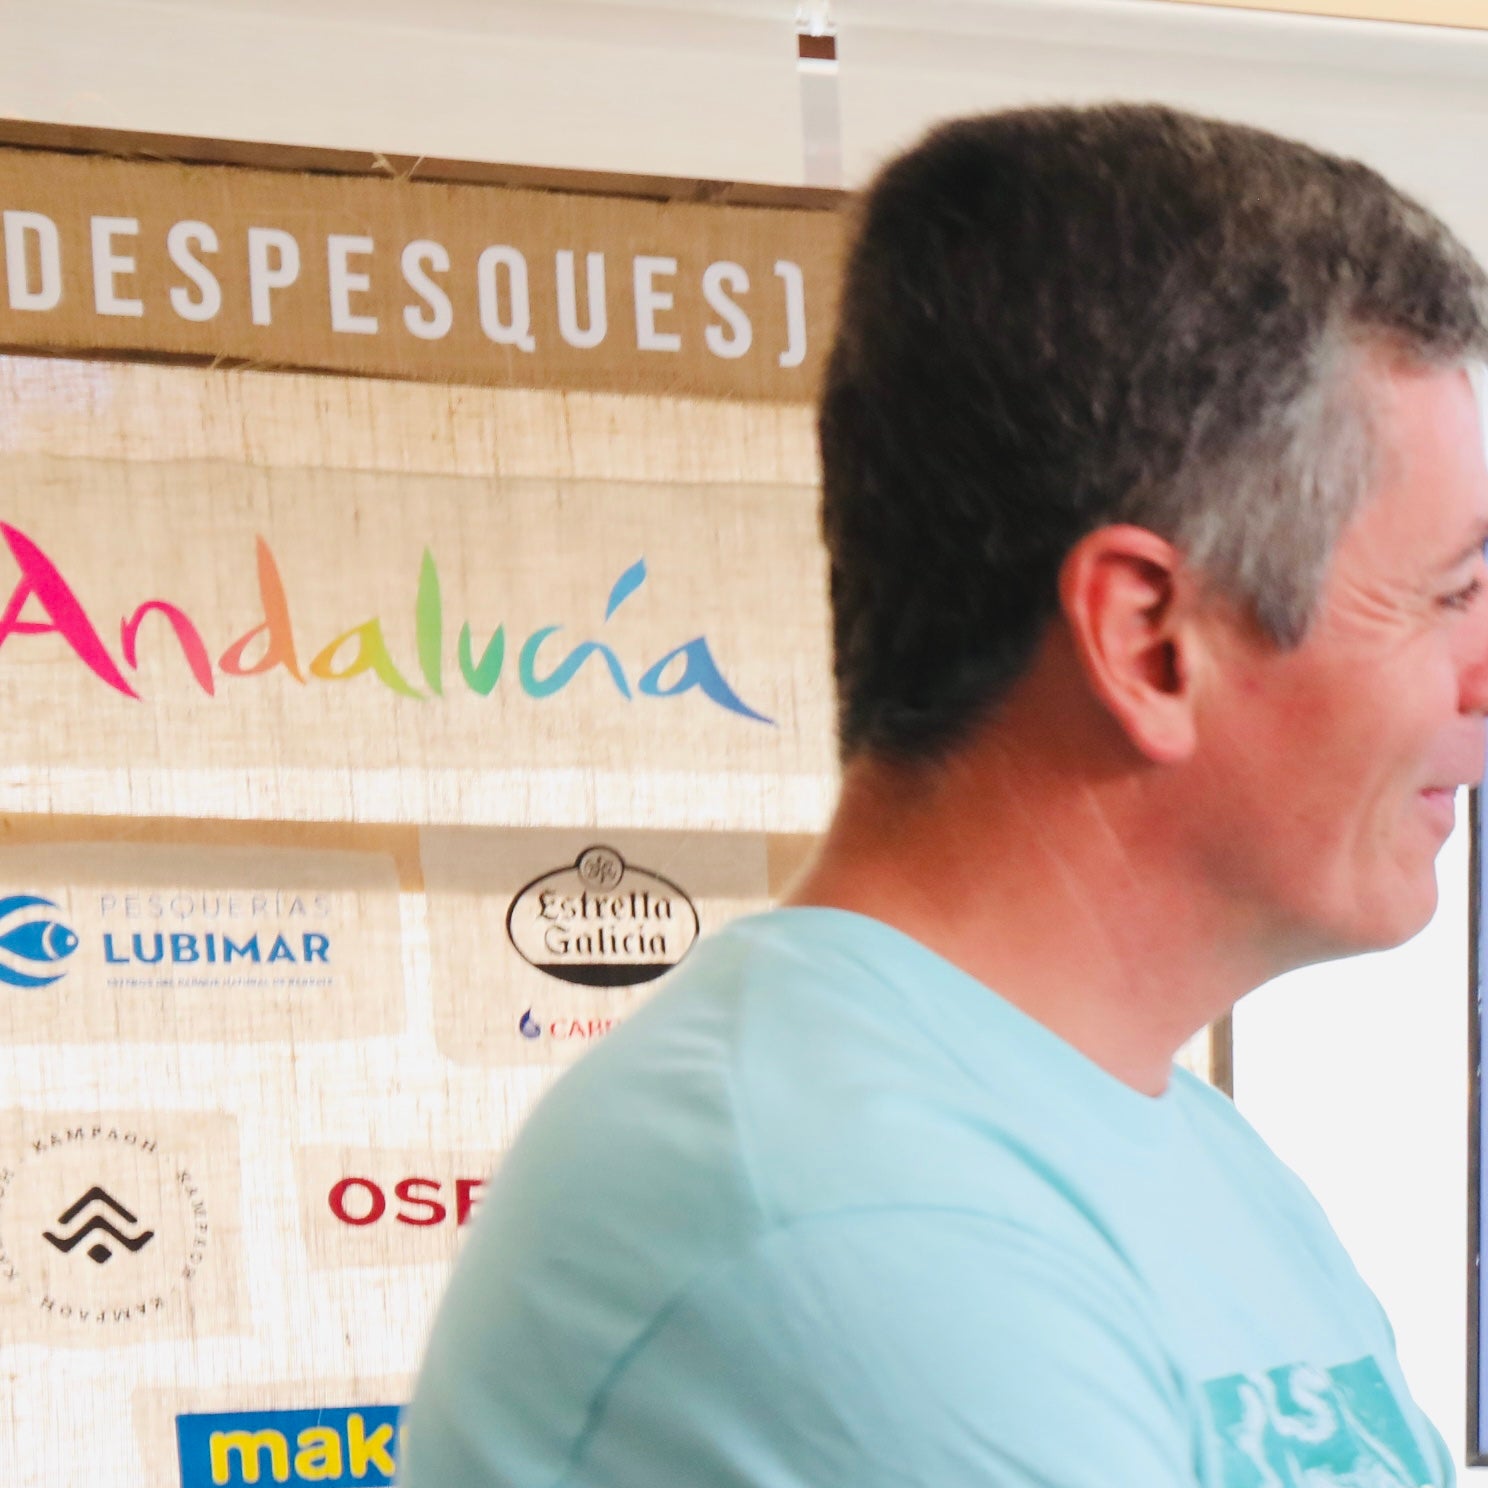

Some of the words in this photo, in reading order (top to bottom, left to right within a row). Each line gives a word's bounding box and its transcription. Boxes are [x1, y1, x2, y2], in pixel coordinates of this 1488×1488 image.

[0, 519, 778, 727] Andalucía
[537, 888, 673, 921] Estrella
[103, 932, 331, 964] LUBIMAR
[545, 923, 667, 955] Galicia
[209, 1412, 407, 1486] mak
